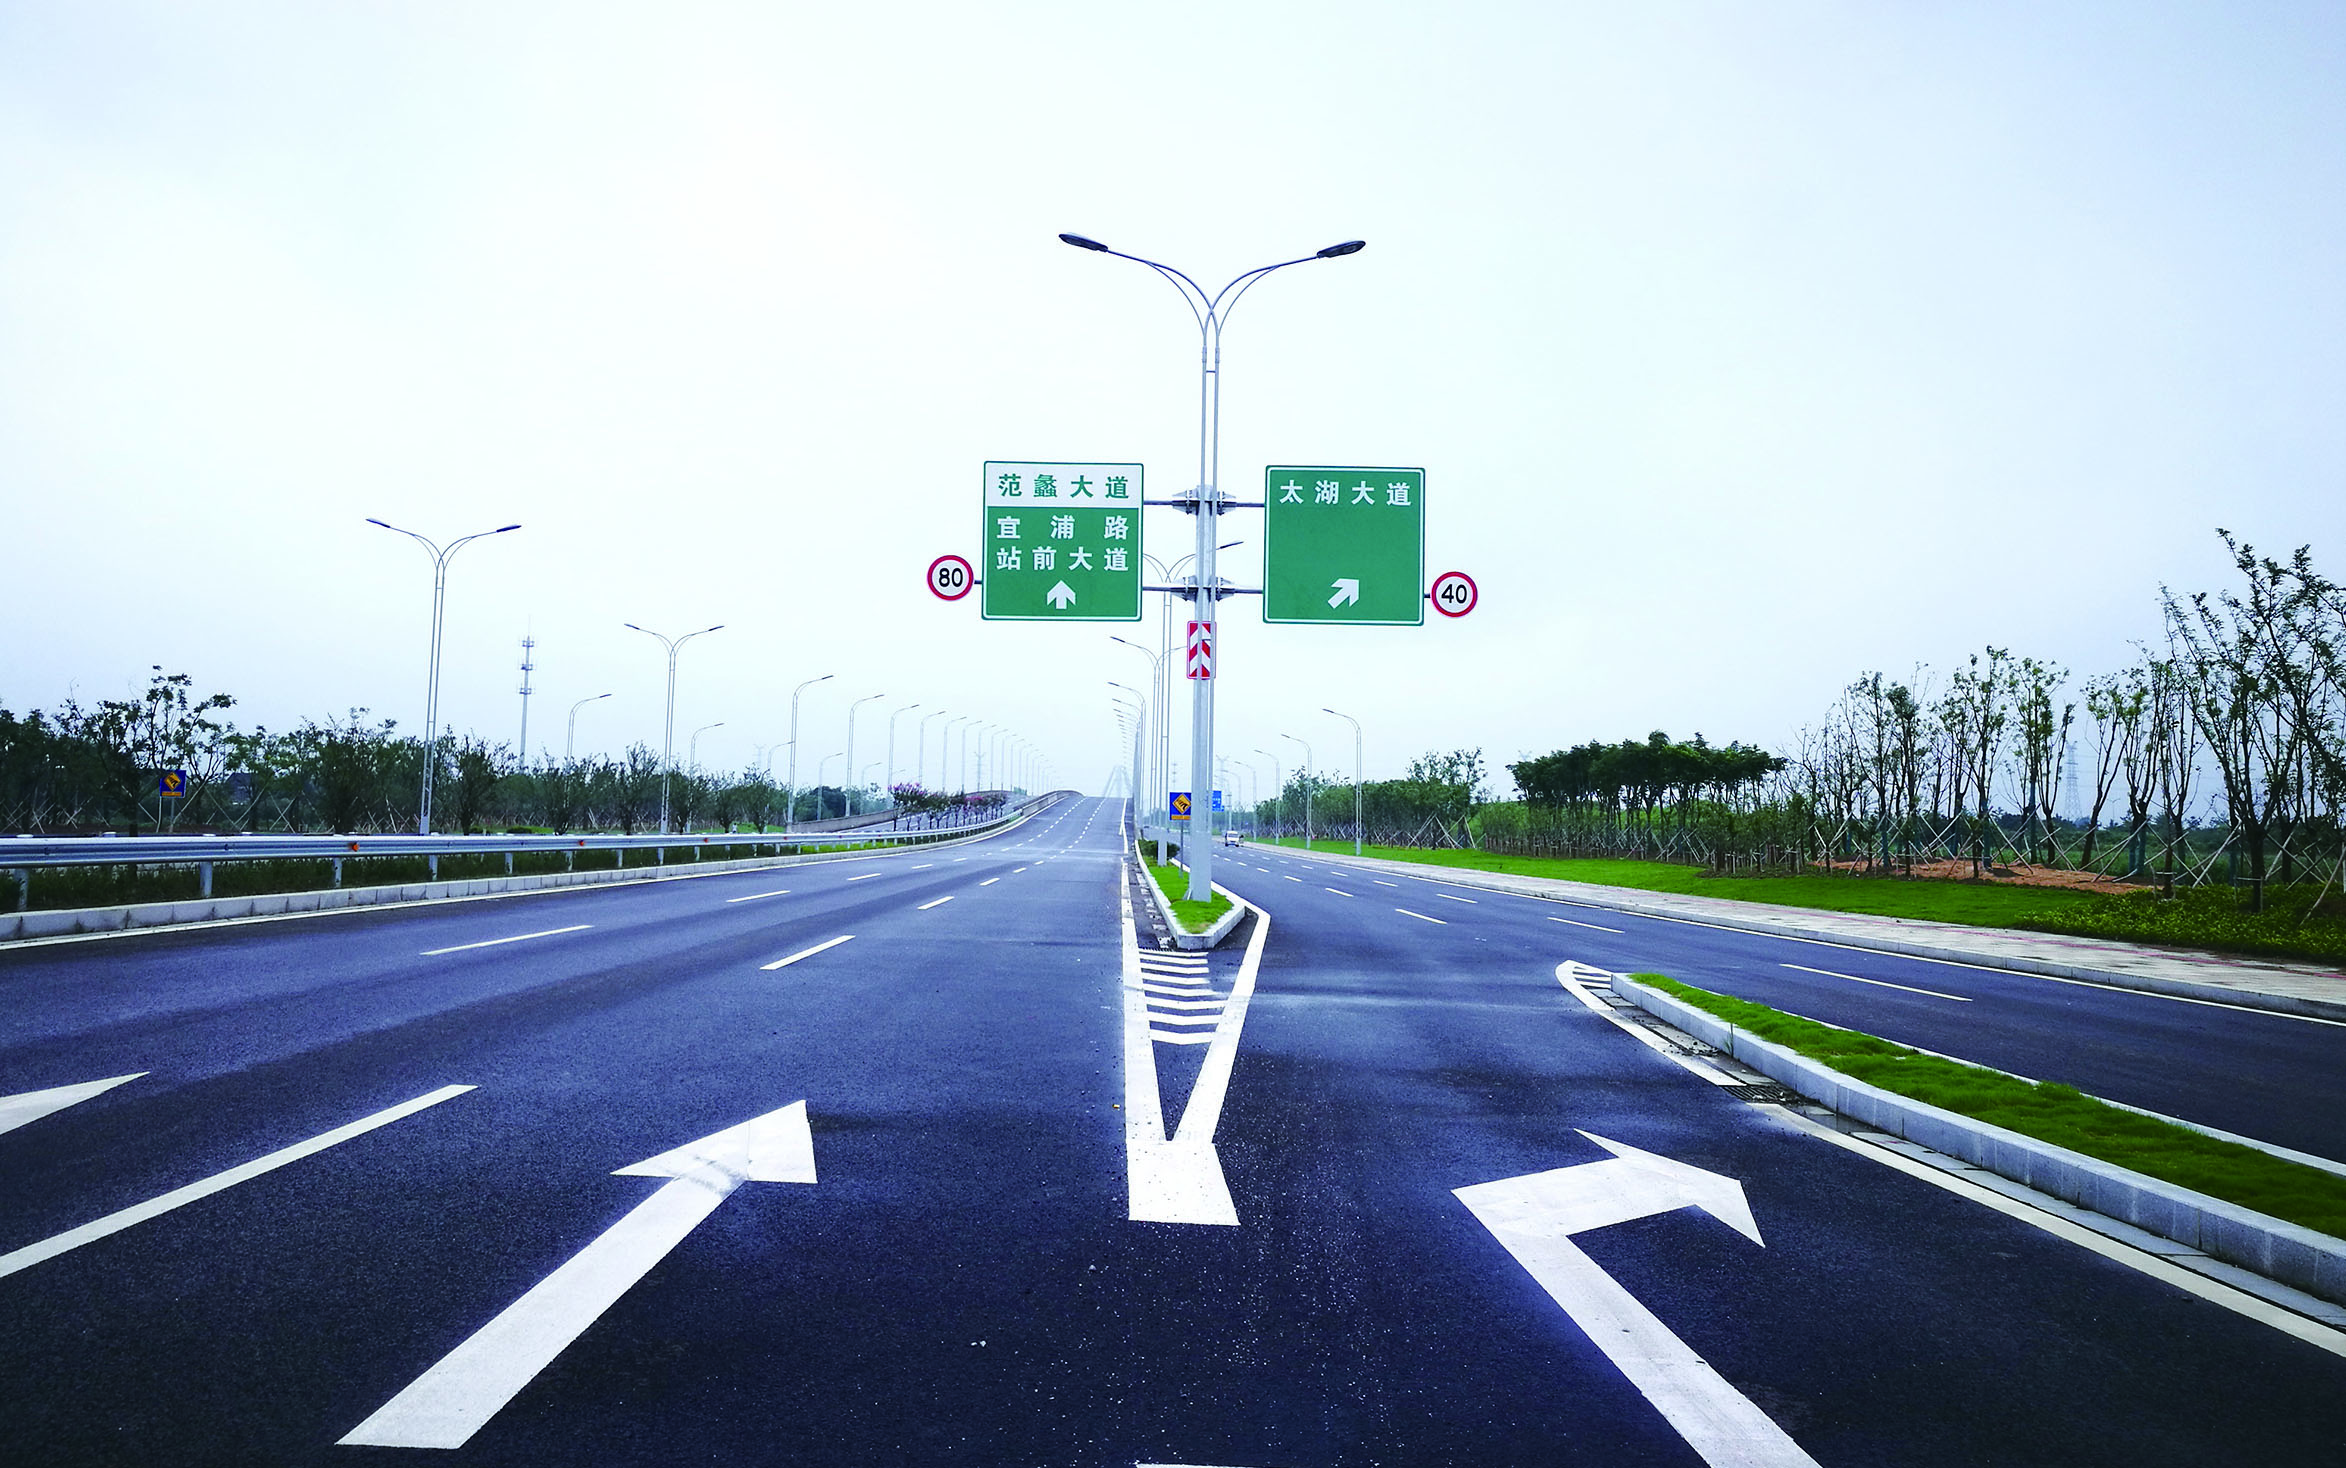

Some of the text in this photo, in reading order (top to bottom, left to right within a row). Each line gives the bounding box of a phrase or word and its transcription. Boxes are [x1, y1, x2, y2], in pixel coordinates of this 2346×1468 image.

[998, 473, 1129, 499] 范蠡大道
[1279, 479, 1411, 506] 太湖大道
[997, 515, 1129, 540] 宜浦路
[997, 546, 1129, 571] 站前大道
[939, 568, 963, 588] 80
[1441, 583, 1468, 604] 40
